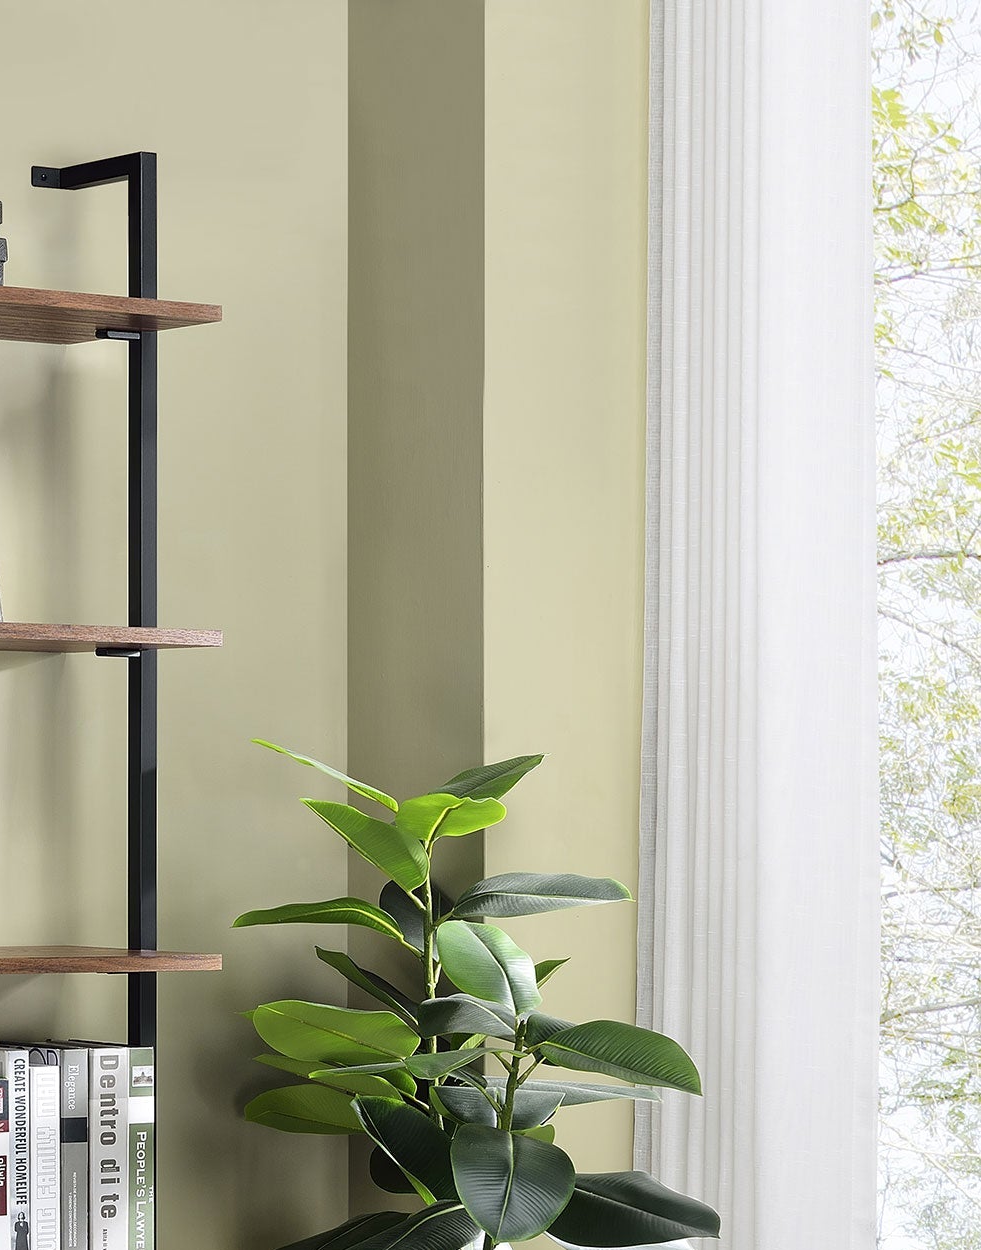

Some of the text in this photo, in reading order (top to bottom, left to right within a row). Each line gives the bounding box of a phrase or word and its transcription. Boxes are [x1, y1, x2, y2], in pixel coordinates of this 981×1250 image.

[36, 1073, 56, 1118] MAN
[64, 1064, 80, 1110] Elegance
[14, 1058, 28, 1205] CREATE WONDERFUL HOMELIFE
[36, 1126, 56, 1199] FAMILY
[100, 1055, 120, 1219] Dentro di te
[136, 1131, 147, 1198] PEOPLE'S
